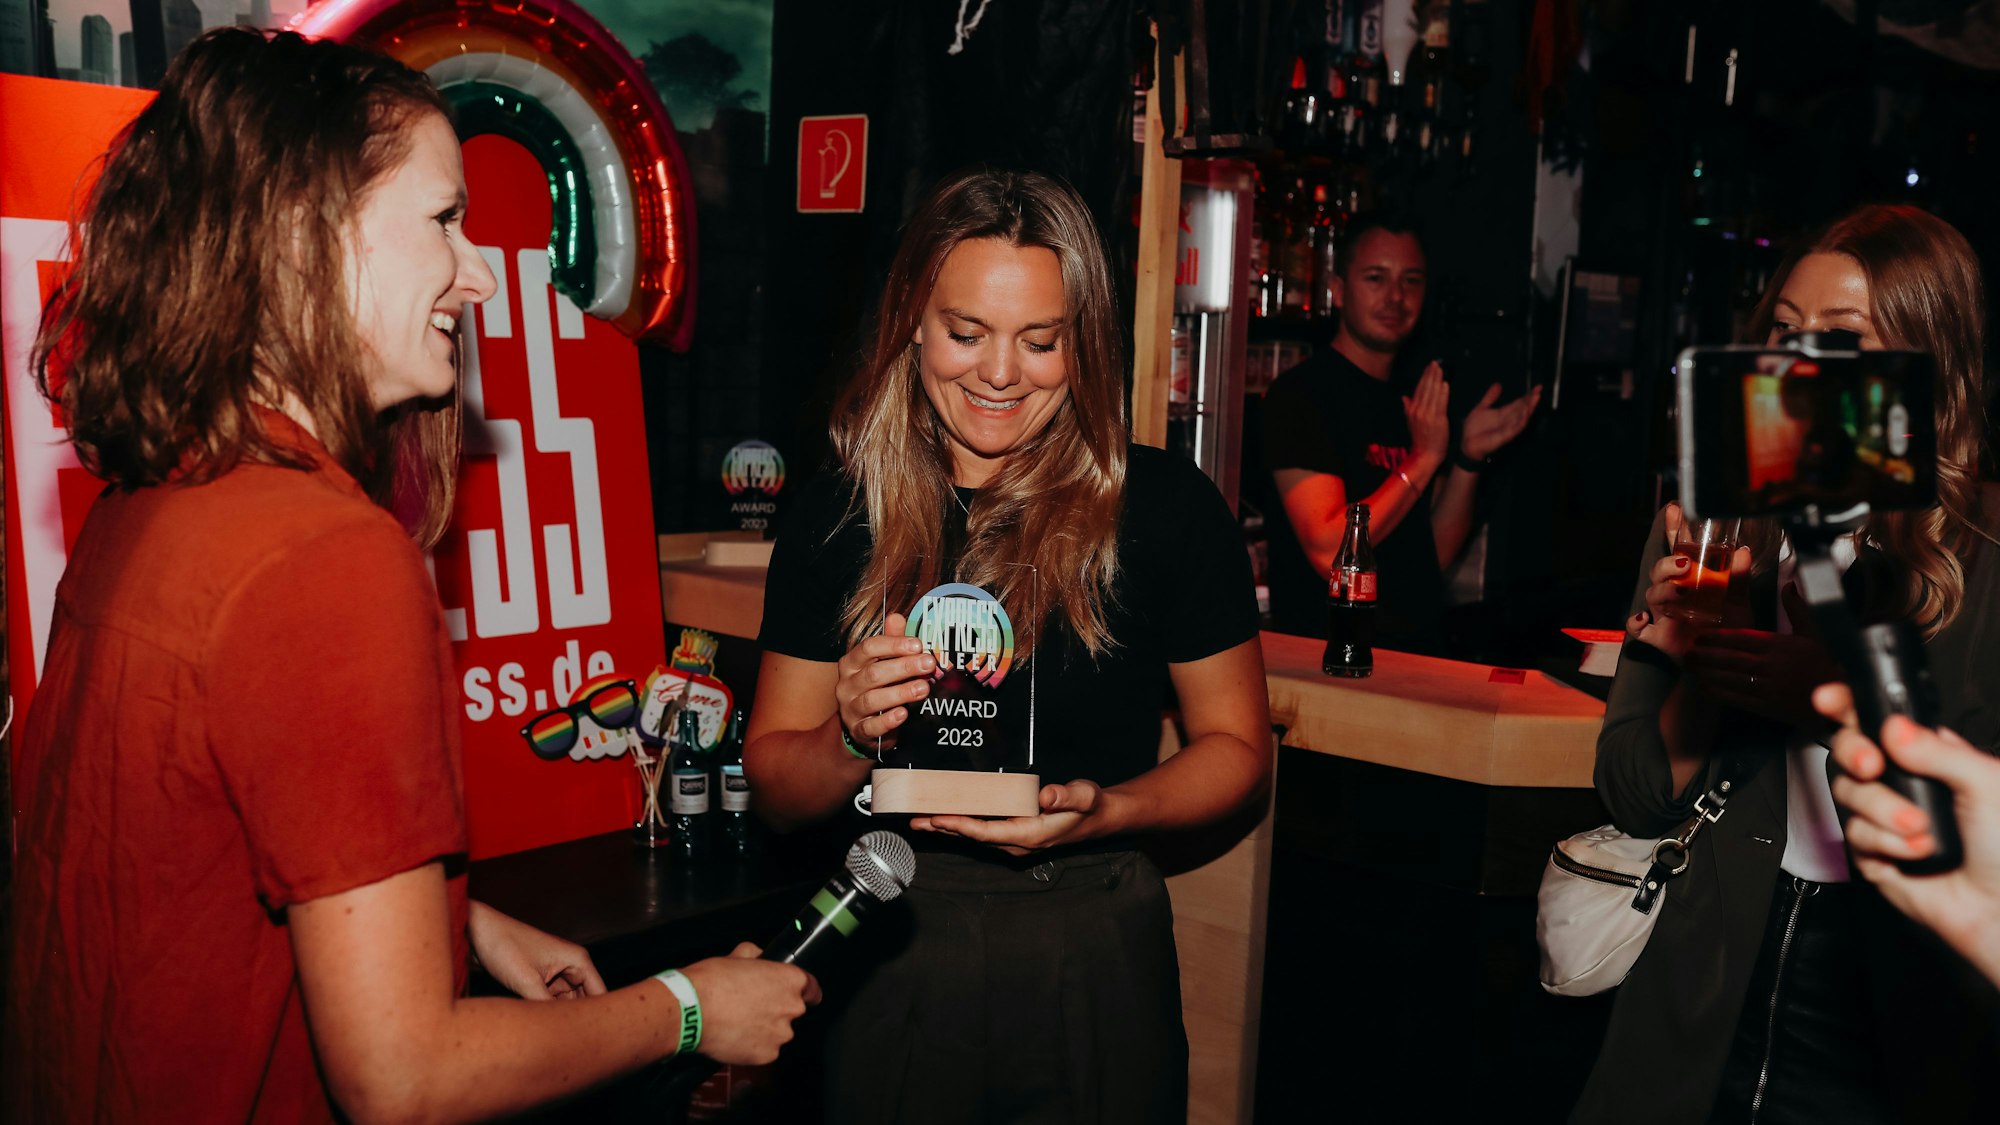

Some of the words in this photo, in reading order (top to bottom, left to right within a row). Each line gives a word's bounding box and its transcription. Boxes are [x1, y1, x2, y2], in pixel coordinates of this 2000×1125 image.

[1175, 247, 1200, 286] ull
[731, 502, 777, 514] AWARD
[741, 518, 768, 530] 2023
[922, 596, 999, 653] EXPRESS
[923, 651, 997, 673] UEER
[920, 698, 997, 718] AWARD
[936, 727, 984, 747] 2023
